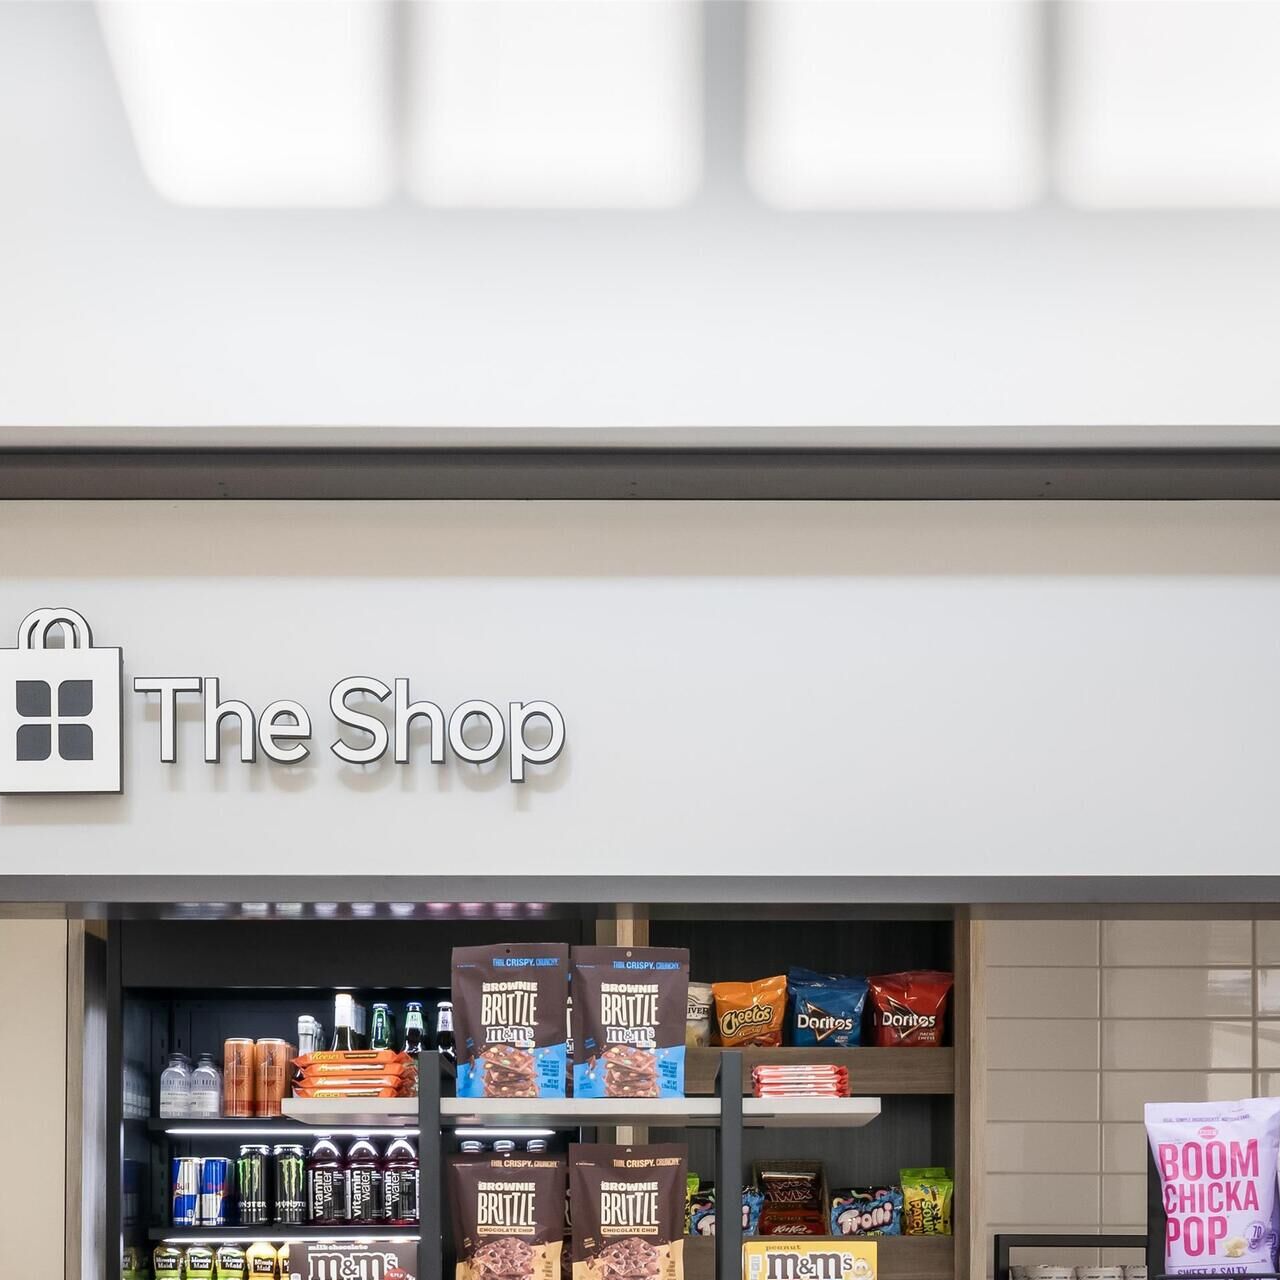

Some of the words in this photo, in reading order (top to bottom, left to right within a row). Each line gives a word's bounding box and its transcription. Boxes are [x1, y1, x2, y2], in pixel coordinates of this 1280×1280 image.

[133, 677, 312, 765] The
[329, 676, 566, 783] Shop
[482, 981, 538, 992] BROWNIE
[601, 982, 658, 993] BROWNIE
[481, 991, 539, 1026] BRITTLE
[601, 993, 660, 1027] BRITTLE
[721, 1004, 773, 1037] Cheetos
[797, 1012, 853, 1031] Doritos
[882, 1011, 936, 1027] Doritos
[1158, 1139, 1259, 1182] BOOM
[314, 1170, 323, 1217] vitamin
[324, 1170, 332, 1202] water
[352, 1170, 361, 1217] vitamin
[362, 1170, 370, 1202] water
[392, 1170, 400, 1202] water
[478, 1181, 536, 1191] BROWNIE
[601, 1181, 658, 1191] BROWNIE
[1164, 1180, 1259, 1214] CHICKA
[478, 1192, 537, 1226] BRITTLE
[601, 1192, 660, 1226] BRITTLE
[838, 1202, 892, 1234] Trolli
[1167, 1216, 1228, 1257] POP
